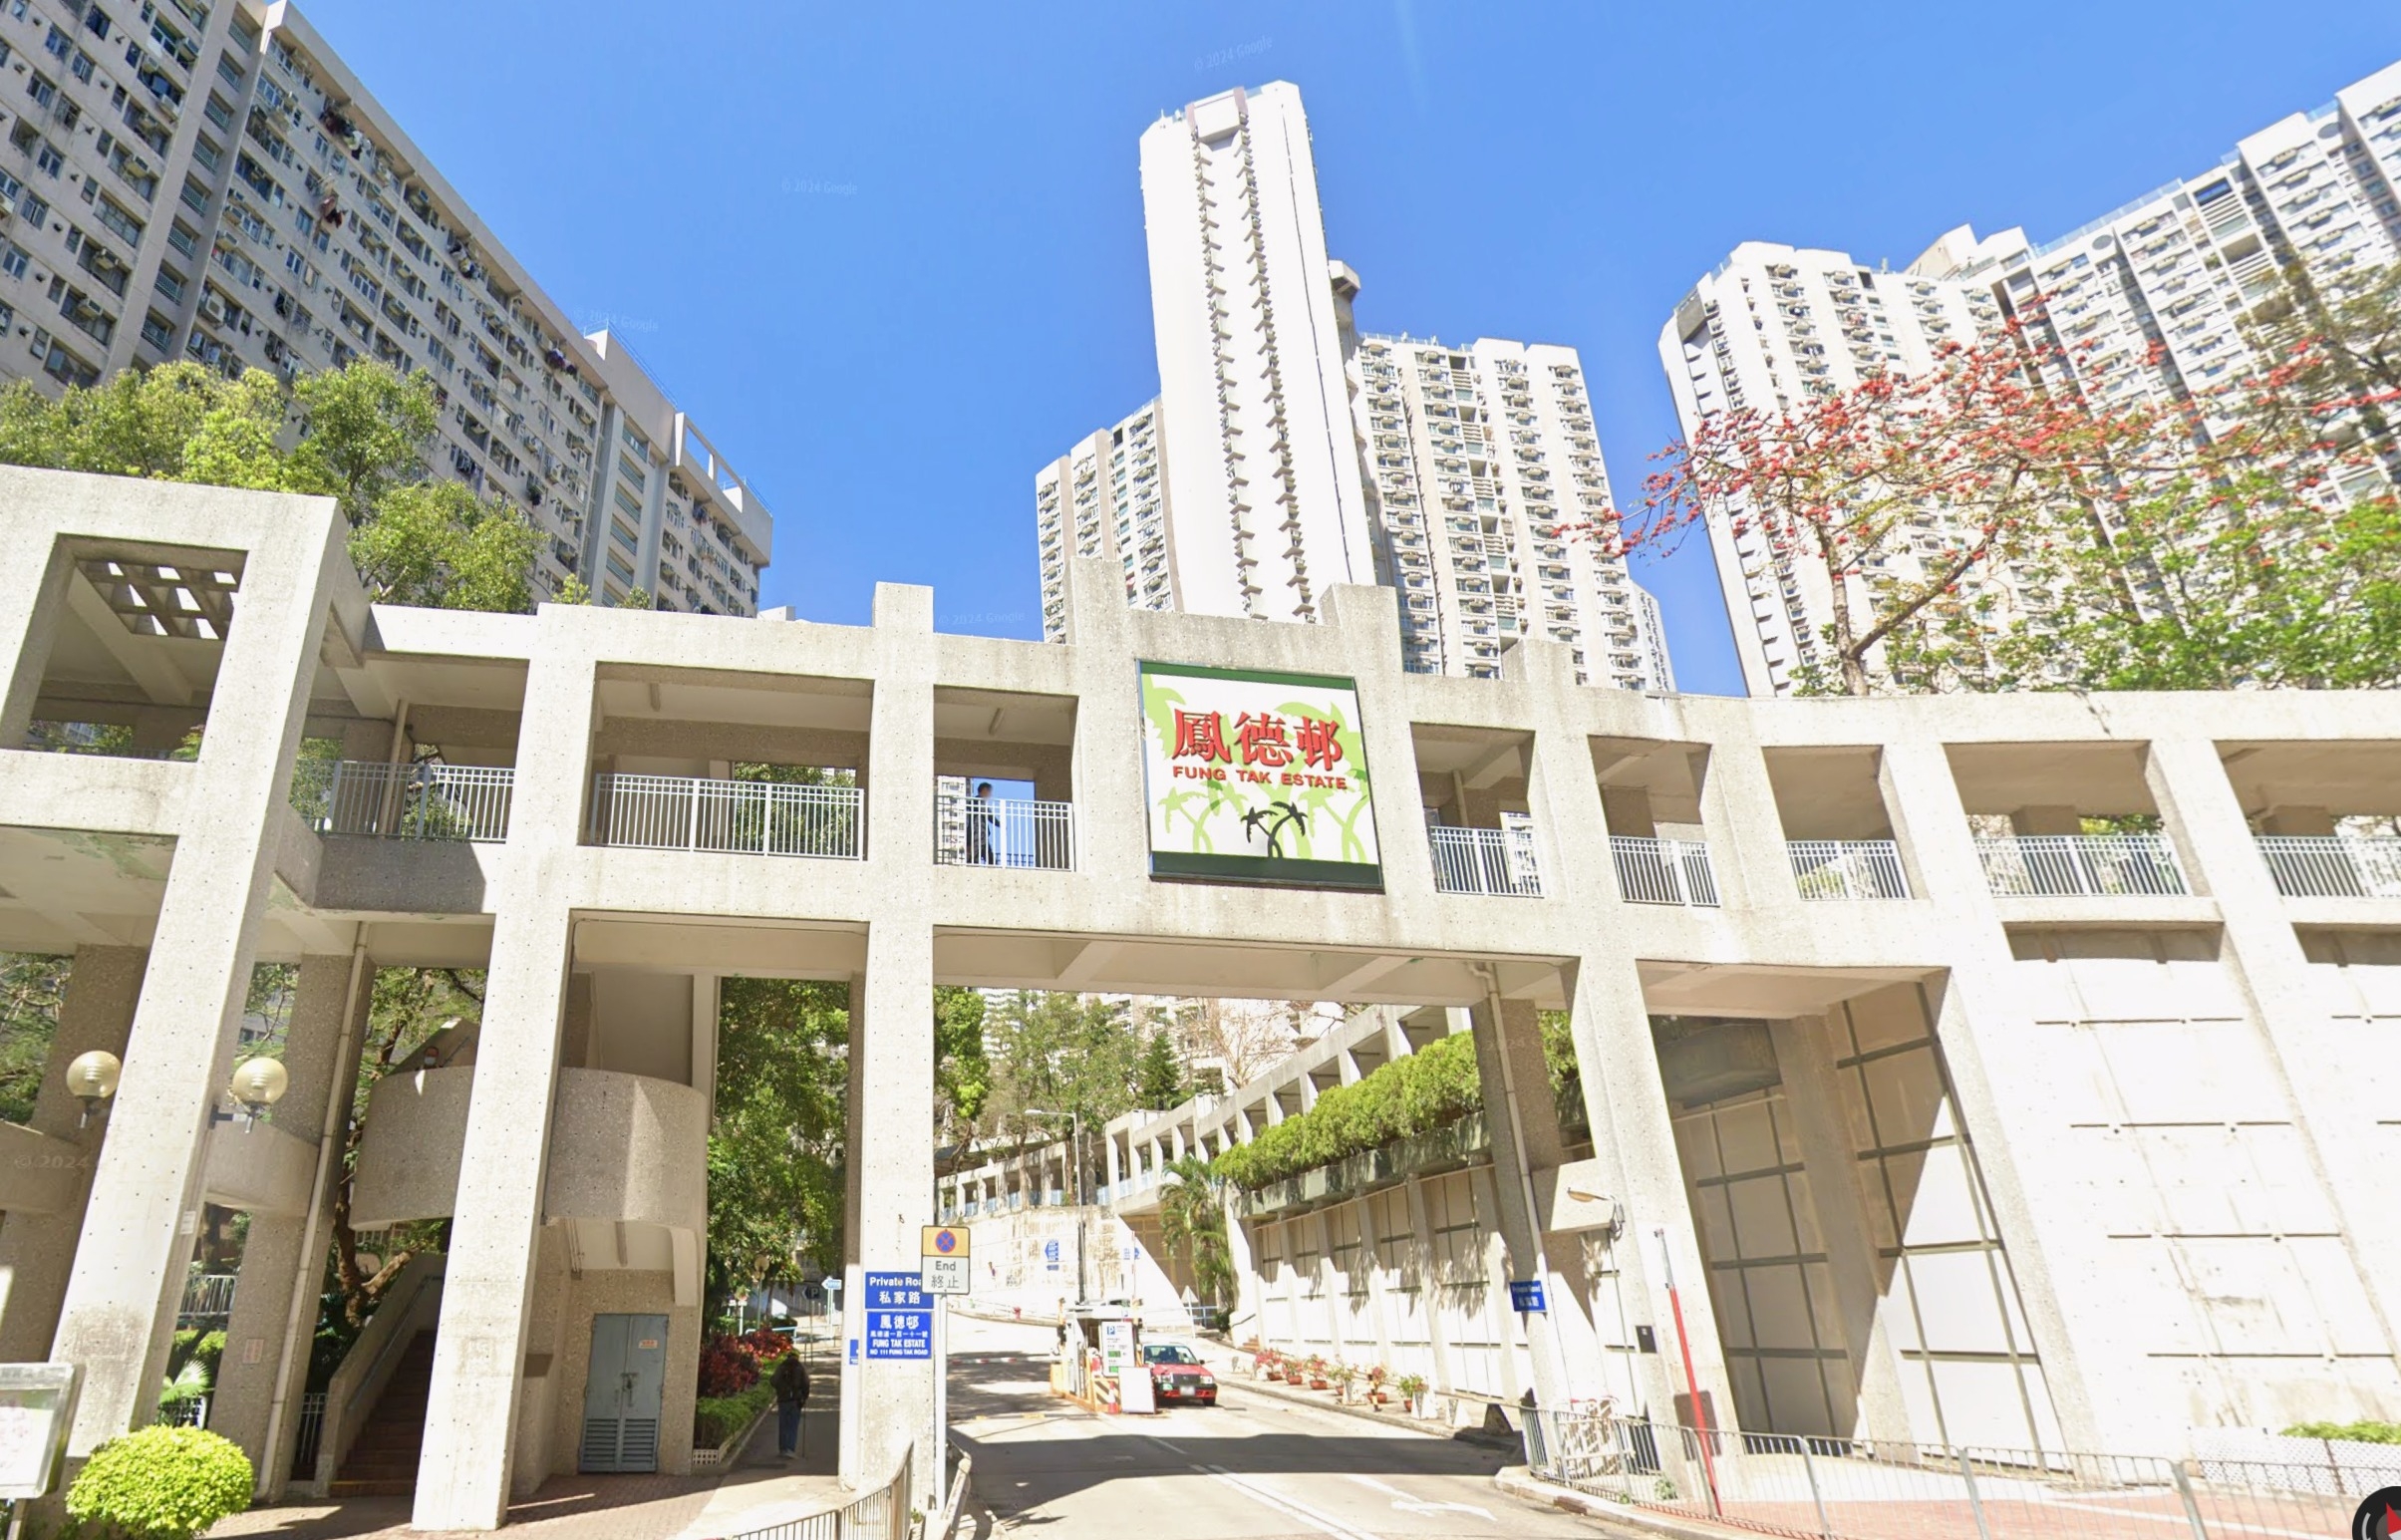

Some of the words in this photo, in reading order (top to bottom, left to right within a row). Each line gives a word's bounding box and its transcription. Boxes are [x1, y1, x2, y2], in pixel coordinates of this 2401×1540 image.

[1171, 708, 1345, 771] 鳳德邨
[1172, 765, 1228, 781] FUNG
[1236, 769, 1273, 784] TAK
[1281, 771, 1348, 789] ESTATE
[935, 1260, 957, 1272] End
[869, 1276, 903, 1287] Private
[905, 1277, 922, 1286] Ro
[931, 1275, 959, 1289] 終止
[879, 1291, 921, 1305] 私家路
[880, 1315, 919, 1330] 鳳德邨
[872, 1339, 889, 1349] FUNG
[890, 1339, 903, 1349] TAK
[904, 1339, 926, 1349] ESTATE
